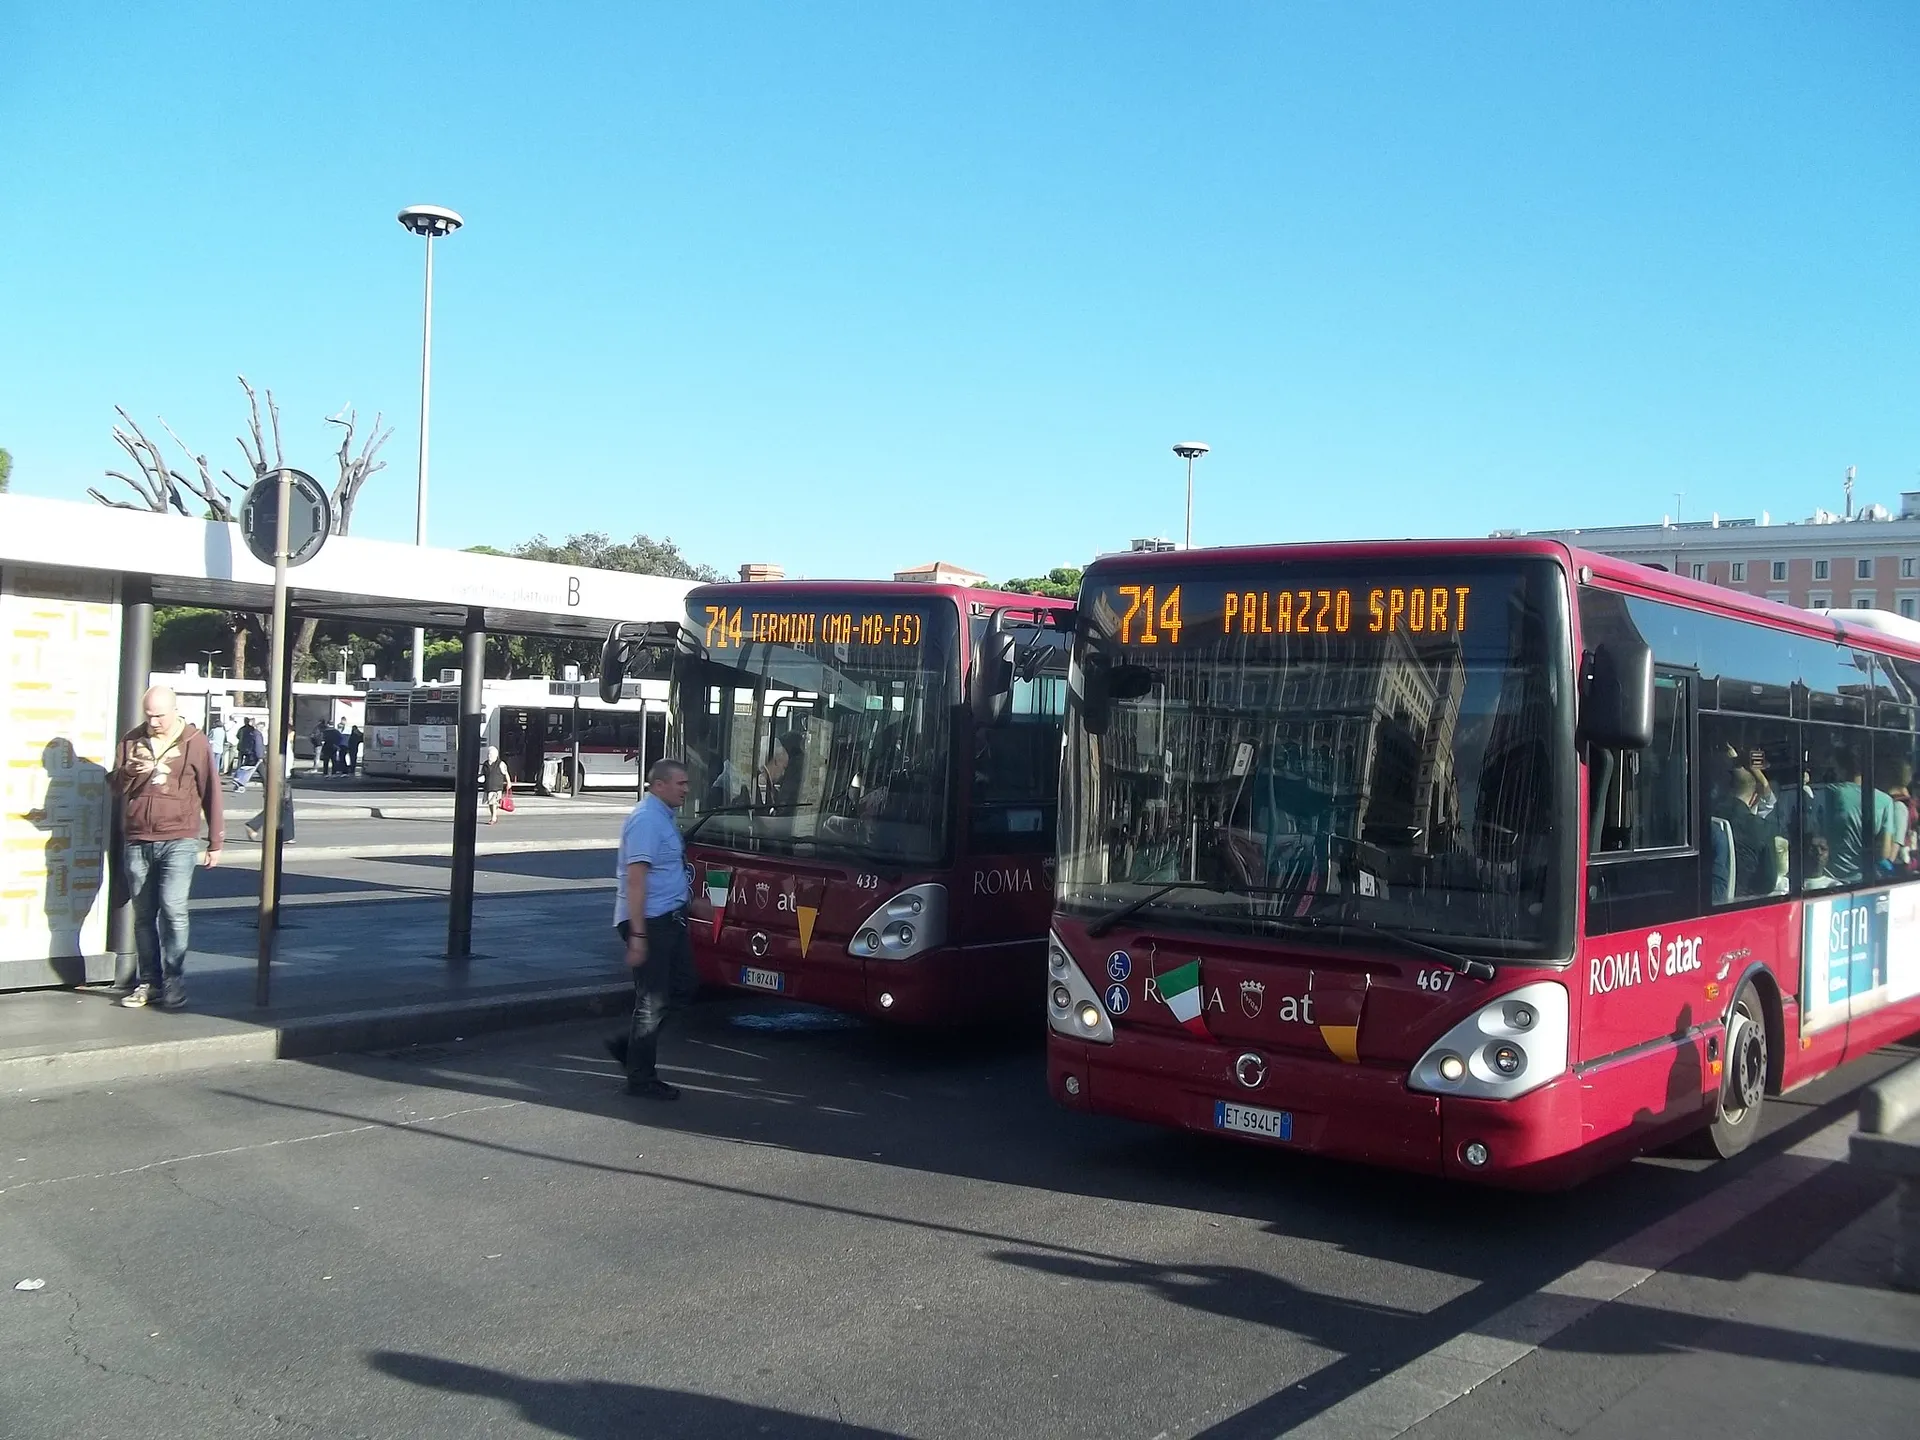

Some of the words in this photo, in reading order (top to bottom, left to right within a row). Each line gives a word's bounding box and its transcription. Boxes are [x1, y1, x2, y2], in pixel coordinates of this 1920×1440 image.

[567, 576, 580, 607] B
[705, 606, 742, 648] 714
[752, 613, 815, 643] TERMINI
[822, 614, 921, 645] (MA-MB-FS)
[1119, 584, 1182, 643] 714
[1224, 590, 1350, 633] PALAZZO
[1369, 587, 1470, 632] SPORT
[702, 881, 747, 905] RMA
[856, 874, 878, 889] 433
[974, 868, 1033, 895] ROMA
[1829, 906, 1868, 953] SETA
[1590, 950, 1642, 996] ROMA
[1665, 934, 1703, 976] atac
[1417, 969, 1455, 992] 467
[1225, 1107, 1240, 1126] ET
[1243, 1111, 1280, 1133] 594LF
